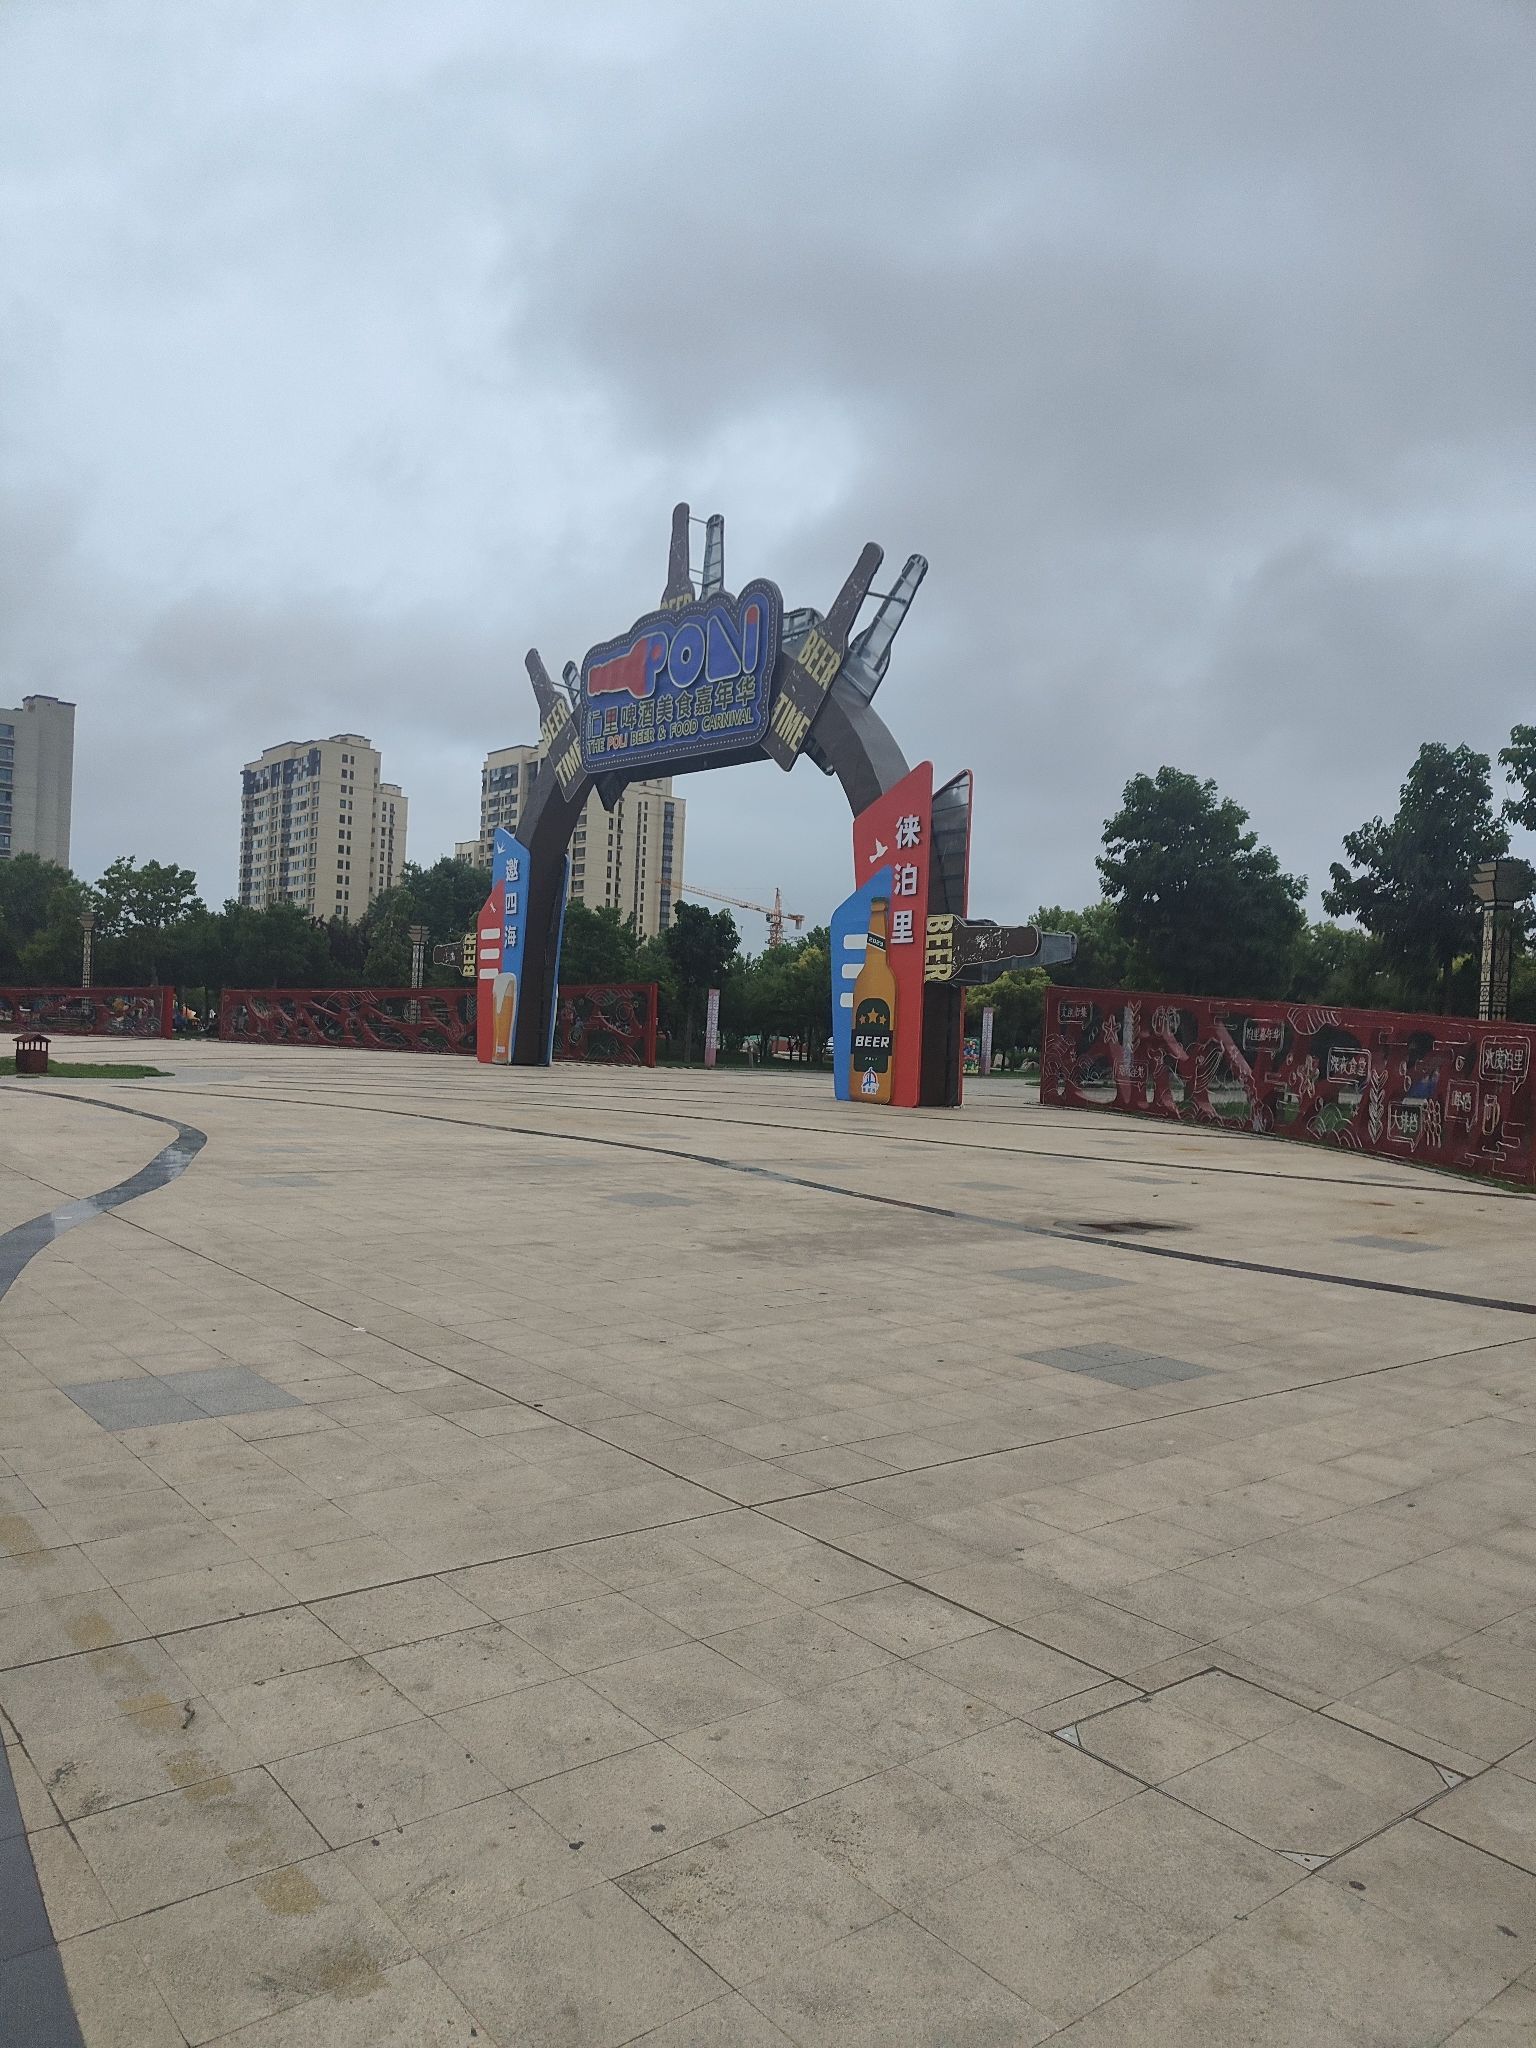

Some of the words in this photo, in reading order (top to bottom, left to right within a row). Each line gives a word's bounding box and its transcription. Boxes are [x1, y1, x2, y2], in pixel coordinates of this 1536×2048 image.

[797, 629, 841, 691] BEER
[539, 698, 571, 751] BEER
[587, 737, 605, 755] THE
[607, 732, 628, 752] POLI
[631, 727, 655, 746] BEER
[657, 726, 667, 741] &
[669, 719, 698, 738] FOOD
[702, 707, 754, 732] CARNIVAL
[771, 692, 812, 753] TIME
[503, 858, 519, 949] 邀四海
[890, 814, 921, 944] 徕泊里
[462, 932, 478, 977] BEER
[868, 936, 884, 948] 2023
[925, 915, 954, 984] BEER
[855, 1035, 890, 1048] BEER
[1330, 1055, 1367, 1077] 深夜食堂
